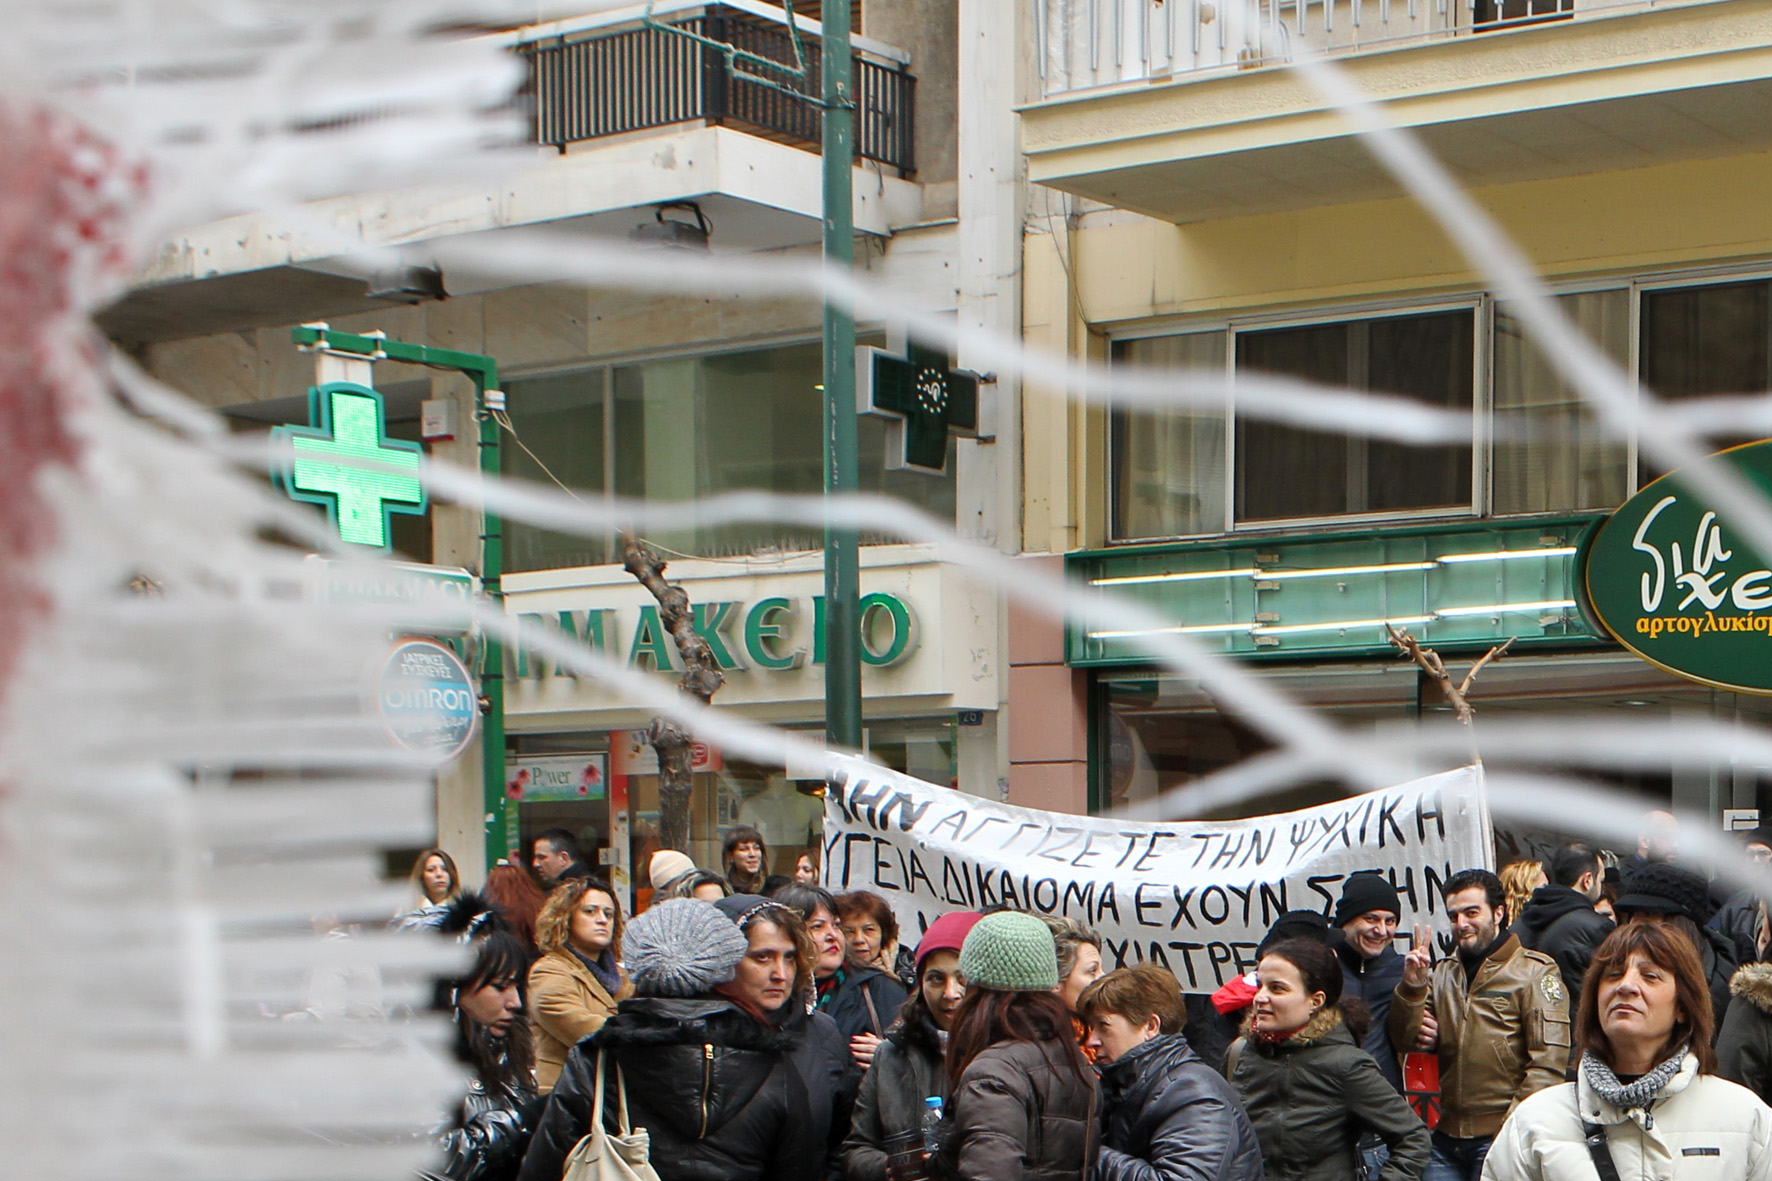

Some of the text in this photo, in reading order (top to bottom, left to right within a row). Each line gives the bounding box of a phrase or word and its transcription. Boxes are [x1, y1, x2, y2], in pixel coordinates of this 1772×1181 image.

[1191, 826, 1276, 871] ΤΗΝ
[1287, 790, 1446, 867] ΨΥΧΙΚΗ
[1135, 877, 1288, 931] ΕΧΟΥΝ
[1307, 861, 1453, 924] ΣΗΝ
